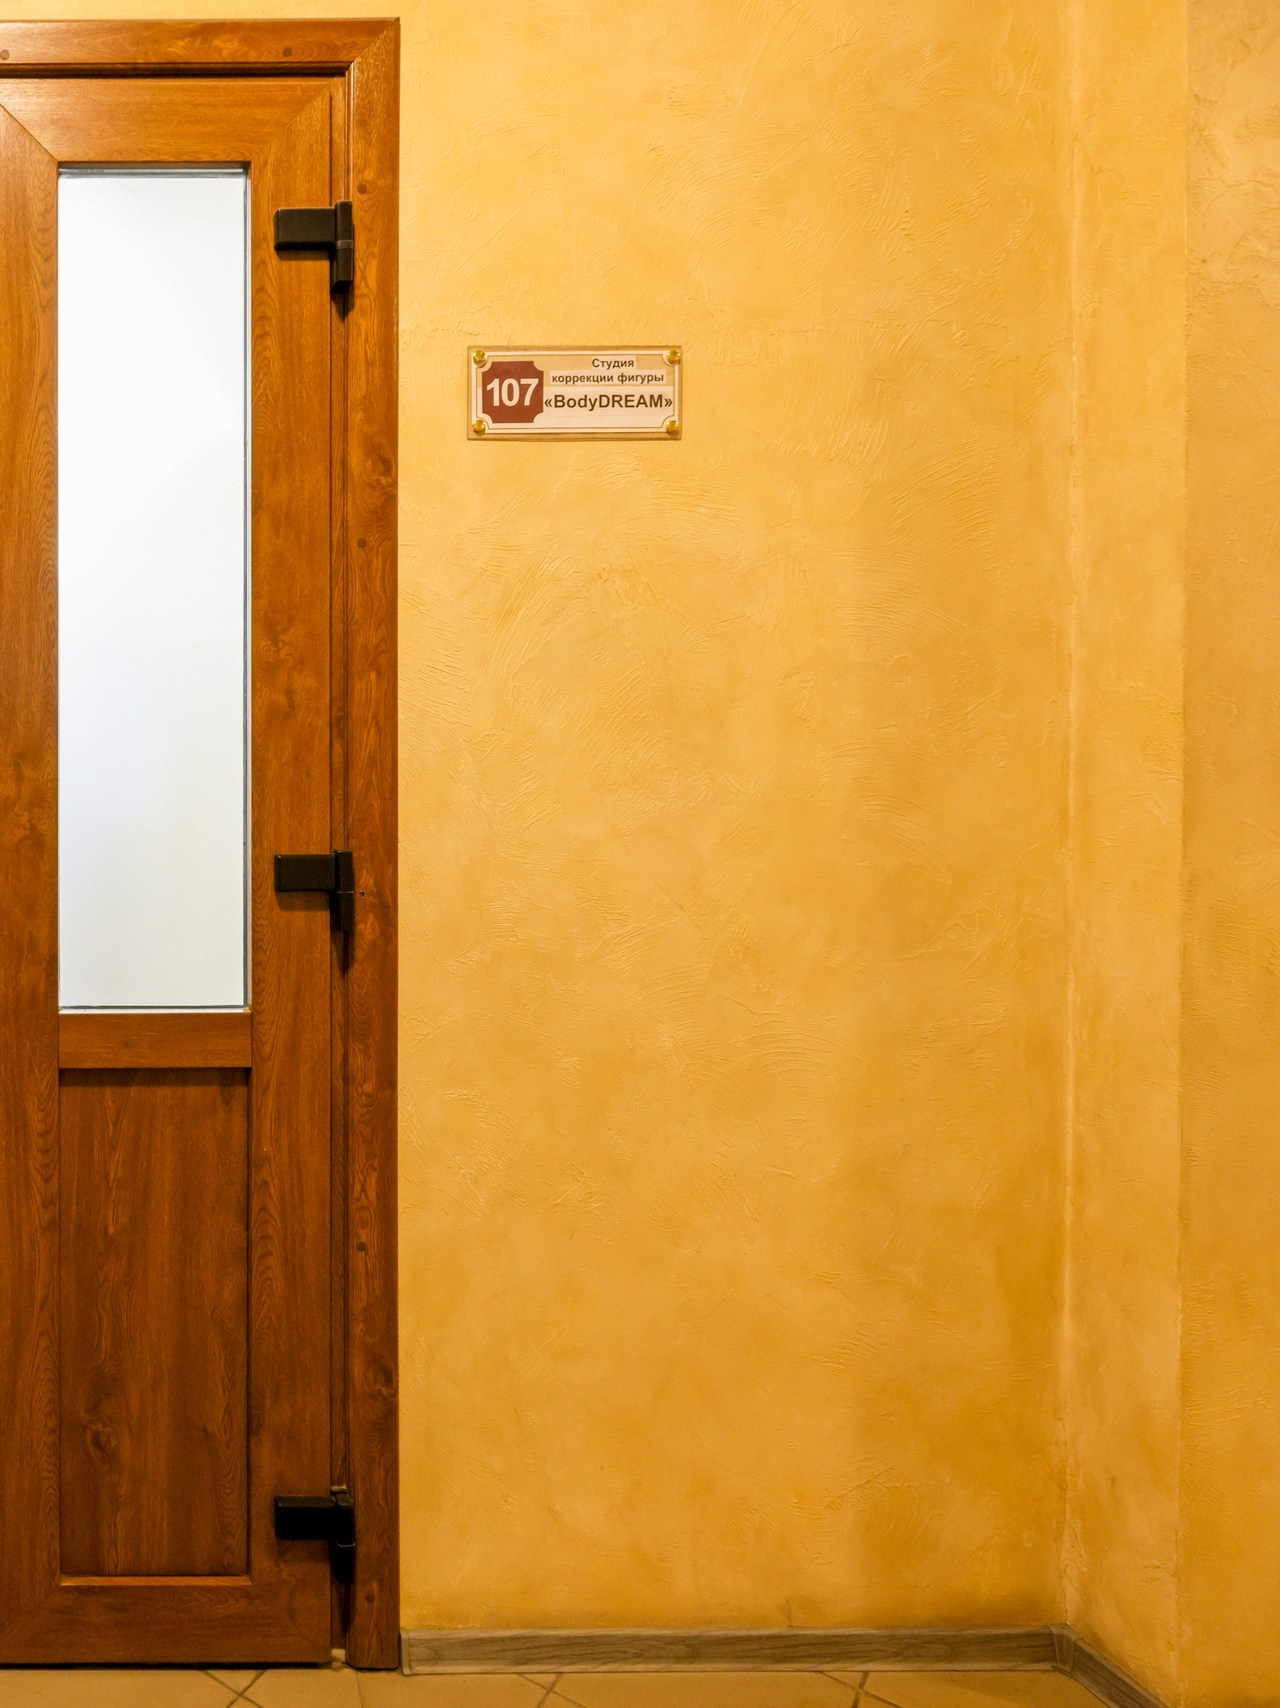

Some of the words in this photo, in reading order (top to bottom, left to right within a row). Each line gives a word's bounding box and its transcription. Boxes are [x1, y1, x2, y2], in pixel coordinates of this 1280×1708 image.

[591, 358, 635, 370] Студия
[552, 374, 614, 385] коррекции
[617, 373, 664, 385] фигуры
[486, 378, 540, 407] 107
[544, 394, 673, 412] «BodyDREAM»
